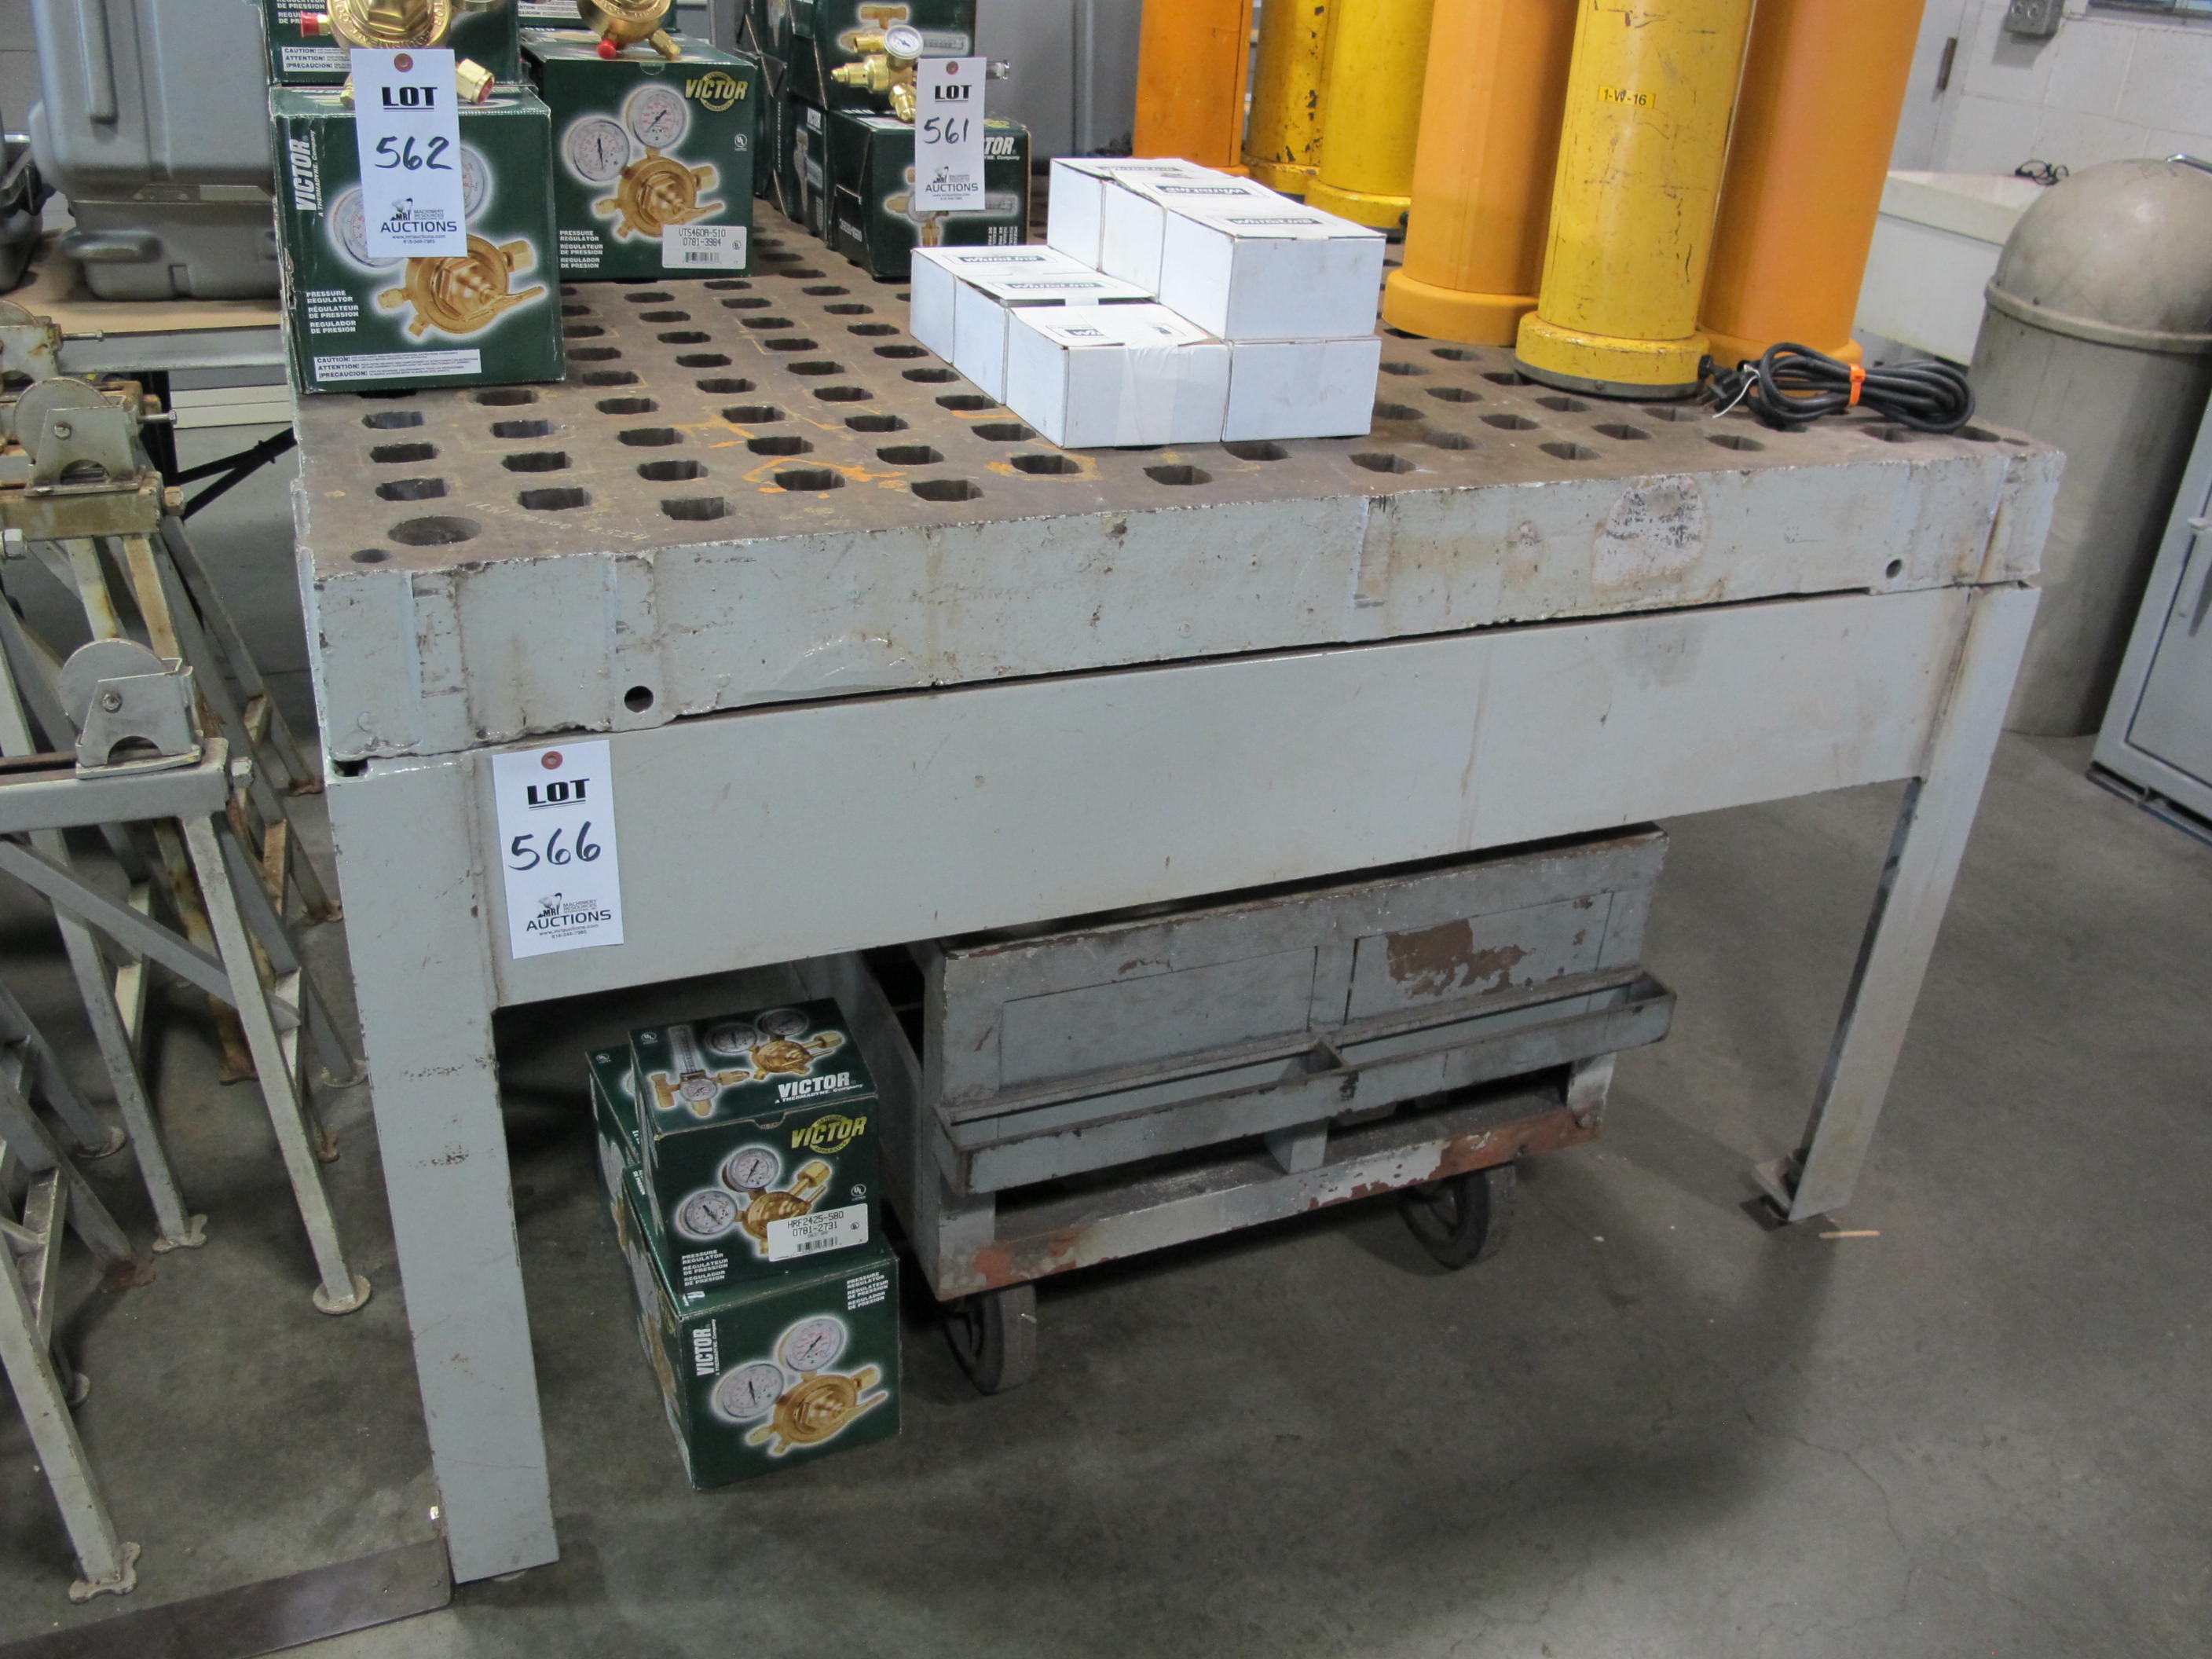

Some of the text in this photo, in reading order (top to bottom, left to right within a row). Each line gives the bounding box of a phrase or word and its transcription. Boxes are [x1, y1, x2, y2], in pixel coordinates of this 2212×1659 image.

[382, 86, 438, 107] LOT
[685, 79, 749, 100] VICTOR
[934, 84, 972, 100] LOT
[1604, 89, 1647, 106] 1-W-16
[923, 116, 969, 145] 561
[309, 129, 318, 161] Company
[374, 135, 453, 171] 562
[985, 137, 1015, 155] TOR
[289, 138, 317, 211] VICTOR
[313, 163, 324, 211] THERMADYNE
[925, 183, 979, 192] AUCTIONS
[395, 210, 411, 221] MRI
[380, 221, 458, 233] AUCTIONS
[683, 237, 722, 246] 0781-3984
[527, 778, 590, 805] LOT
[508, 820, 601, 871] 566
[543, 906, 560, 917] MRI
[526, 910, 612, 932] AUCTIONS
[778, 1071, 850, 1098] VICTOR
[833, 1084, 863, 1093] Company
[791, 1116, 867, 1148] VICTOR
[787, 1210, 844, 1229] HRF2425-580
[792, 1221, 838, 1237] 0781-2731
[681, 1249, 718, 1260] PRESSURE
[682, 1253, 724, 1265] REGULATOR
[683, 1270, 726, 1282] REGULADOR
[694, 1263, 728, 1273] PRESSION
[847, 1272, 880, 1284] PRESSURE
[847, 1274, 885, 1289] REGULATOR
[848, 1291, 886, 1306] REGULADOR
[857, 1284, 888, 1297] PRESSION
[693, 1328, 715, 1376] VICTOR
